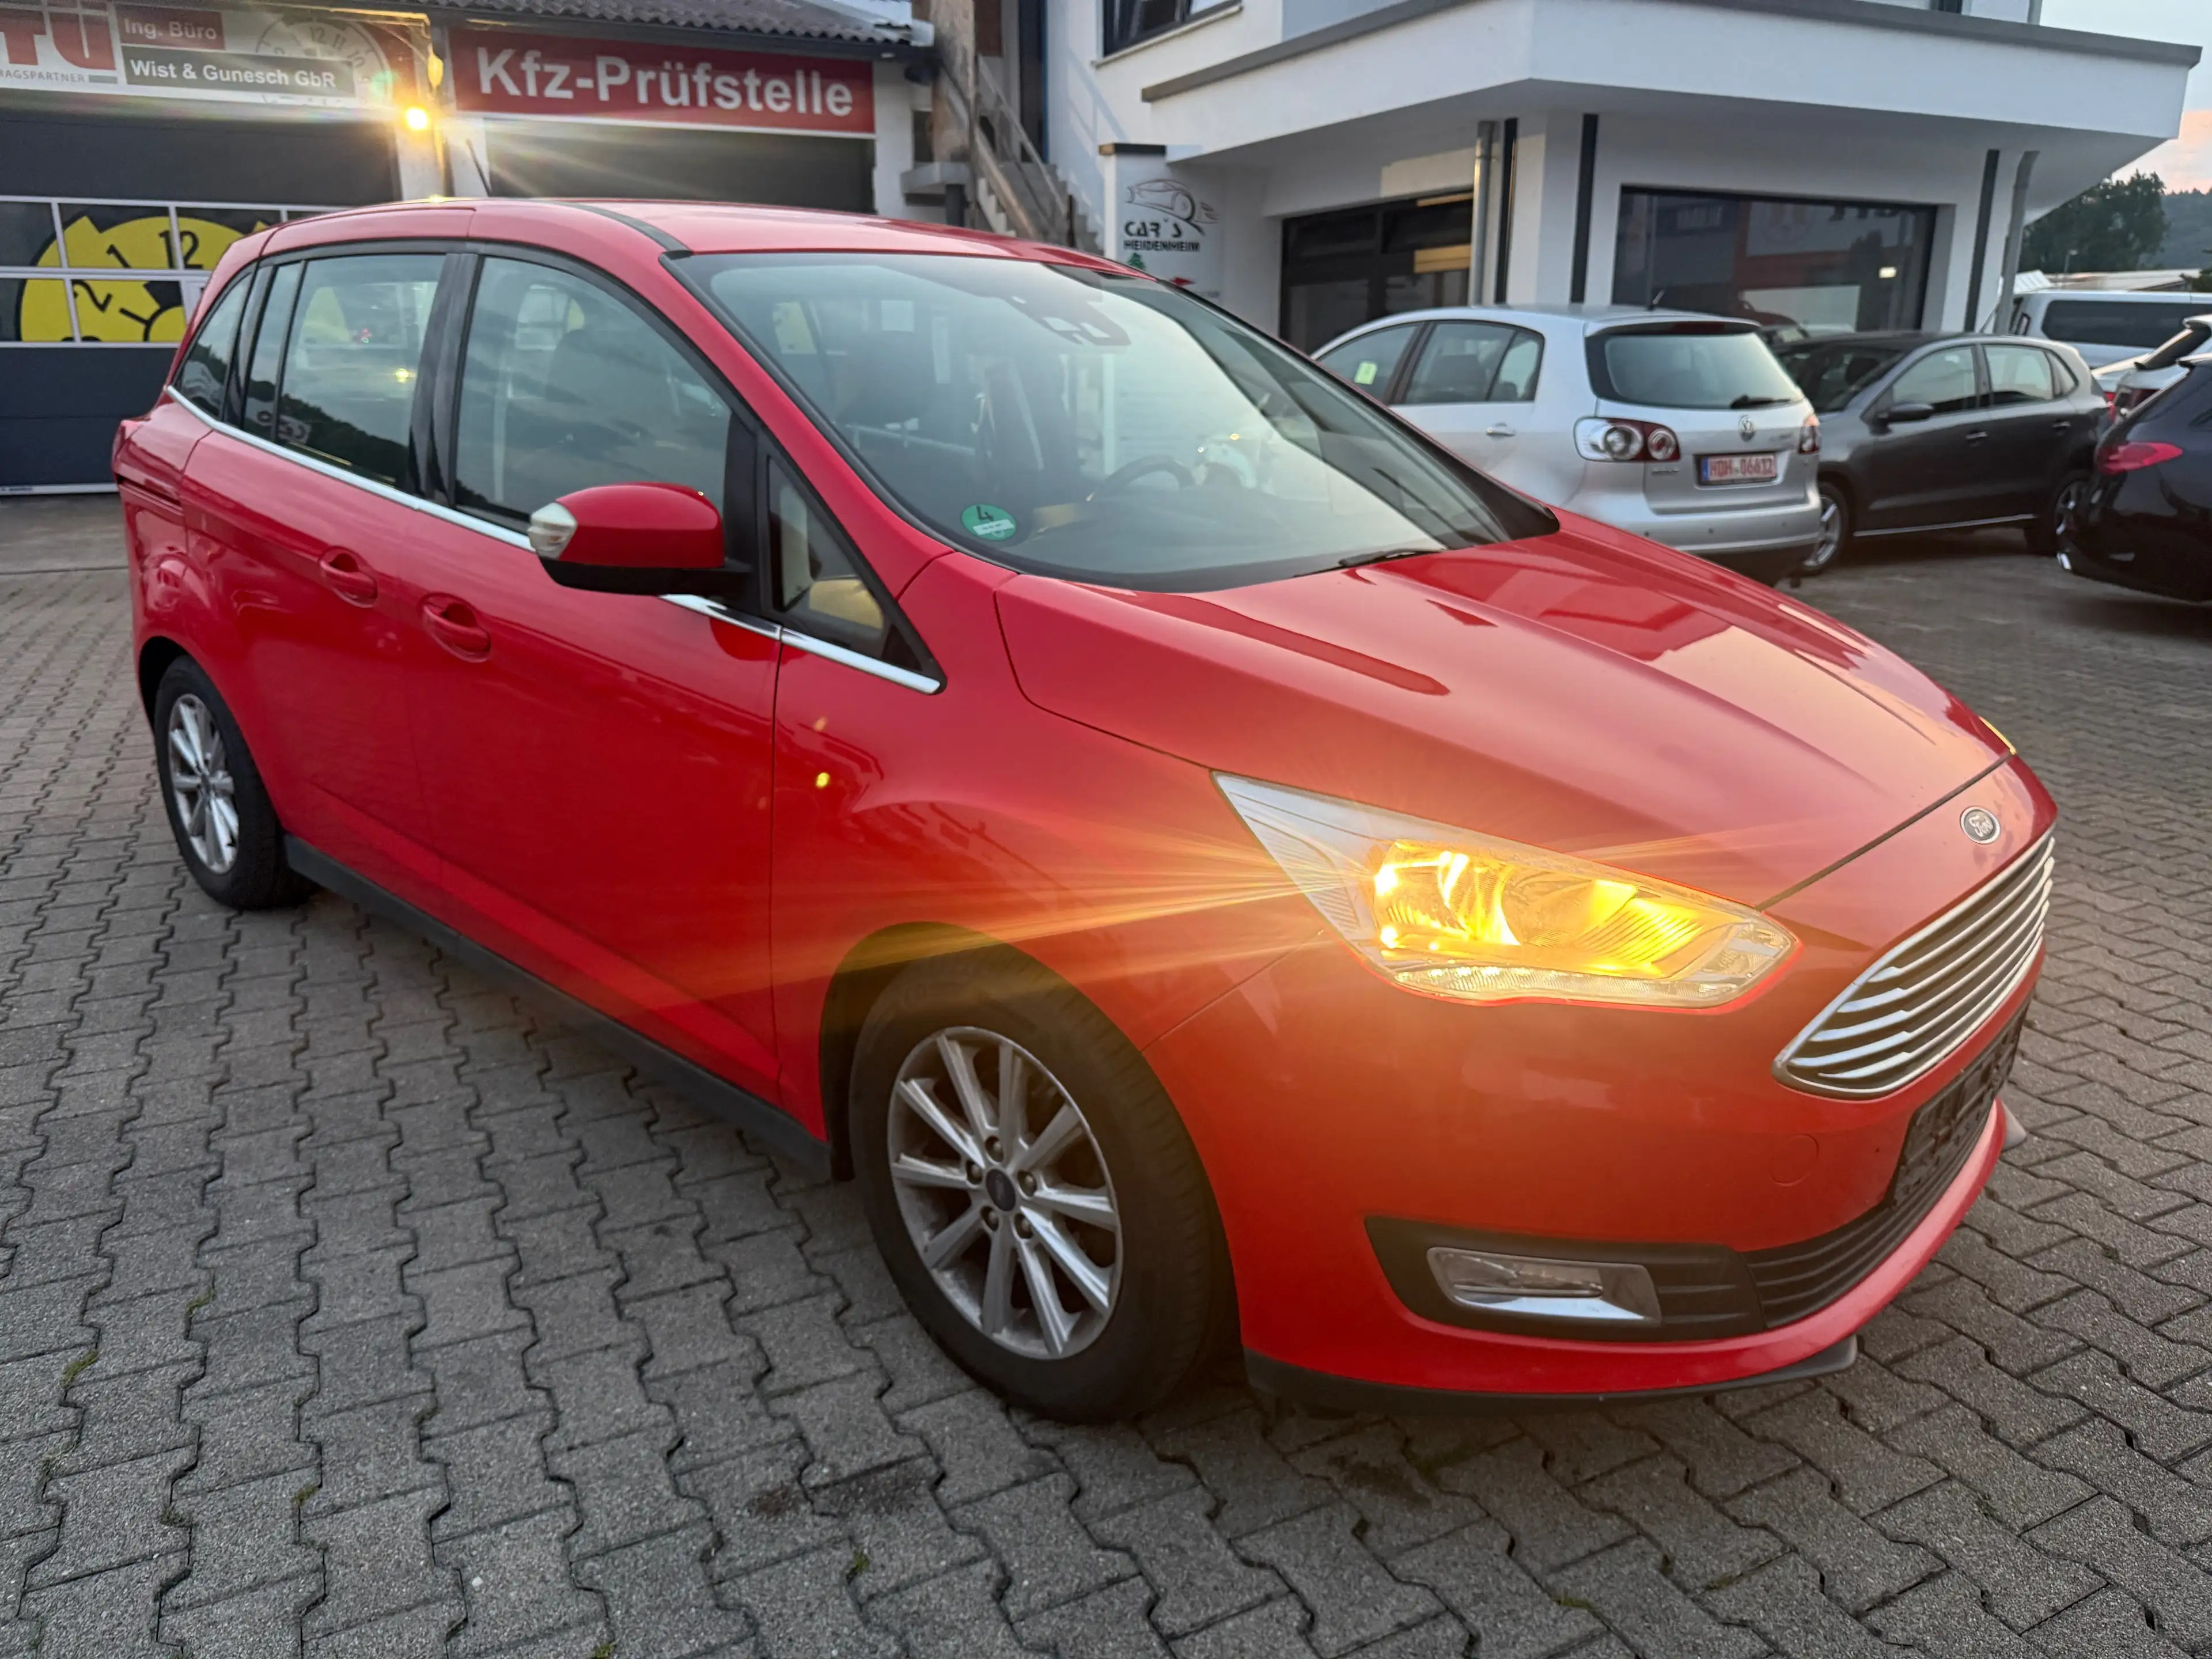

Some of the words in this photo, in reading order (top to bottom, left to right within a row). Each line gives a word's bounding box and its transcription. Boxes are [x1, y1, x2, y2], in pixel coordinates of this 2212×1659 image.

[124, 18, 164, 39] Ing.
[169, 22, 218, 39] Büro
[130, 59, 177, 78] Wist
[182, 62, 197, 79] &
[202, 64, 289, 85] Gunesch
[294, 70, 336, 88] GbR
[476, 46, 854, 117] Kfz-Prüfstelle
[1124, 240, 1200, 252] HEIDENHEIM
